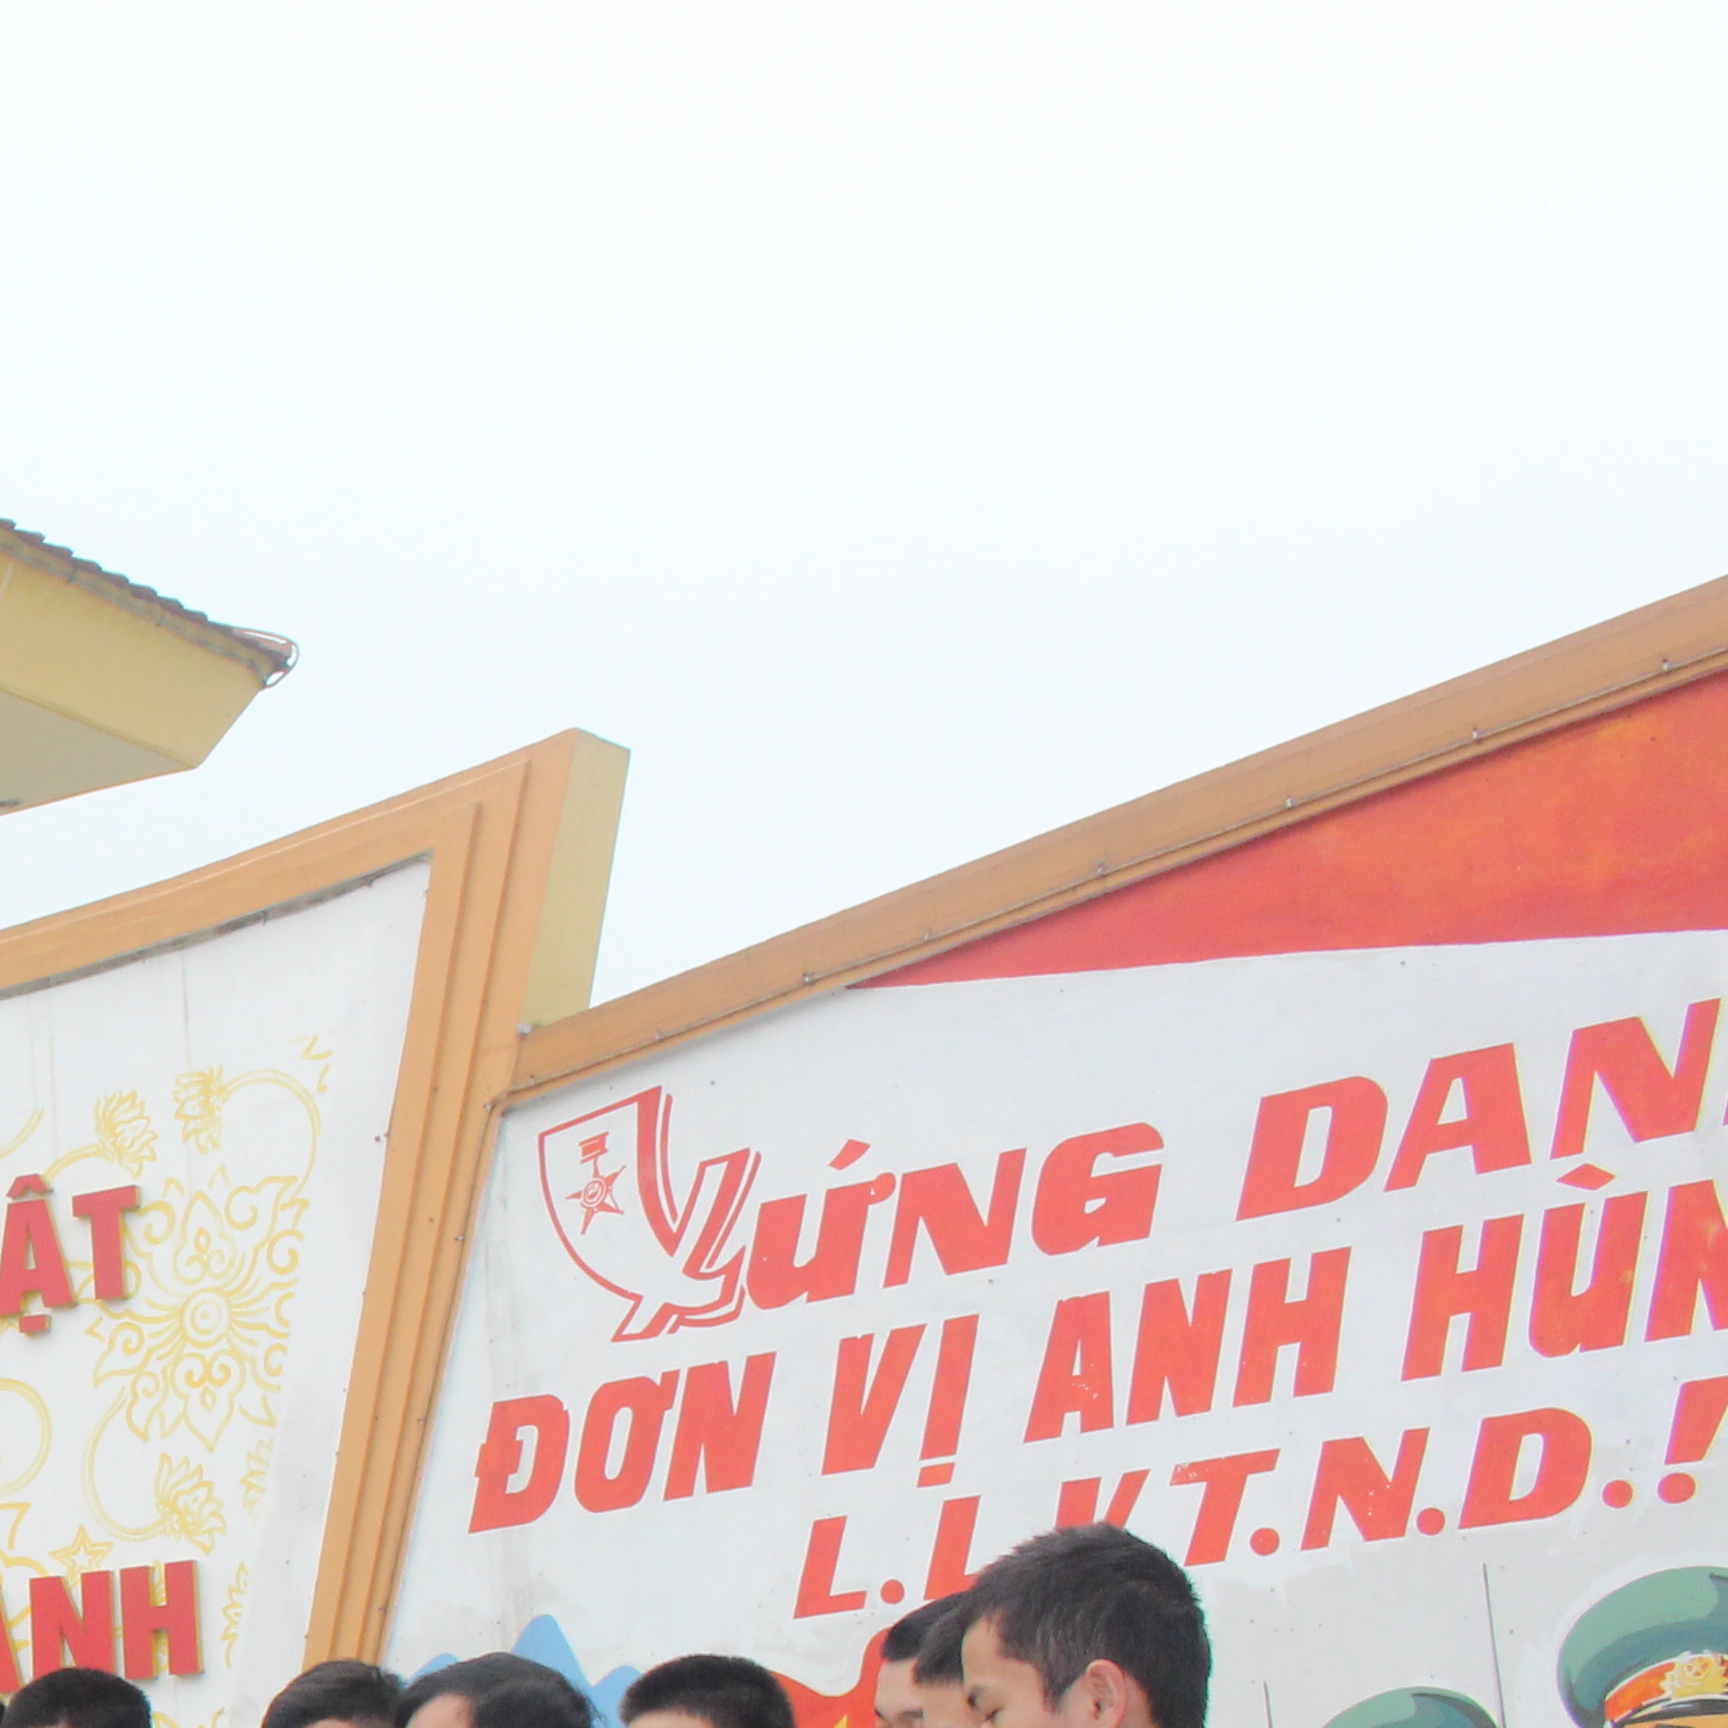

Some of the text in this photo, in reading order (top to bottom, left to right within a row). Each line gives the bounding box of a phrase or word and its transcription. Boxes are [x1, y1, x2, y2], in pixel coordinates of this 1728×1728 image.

[1236, 998, 1728, 1221] DAN
[469, 1353, 775, 1533] ĐƠN
[821, 1315, 979, 1489] VỊ
[1023, 1245, 1352, 1444] ANH
